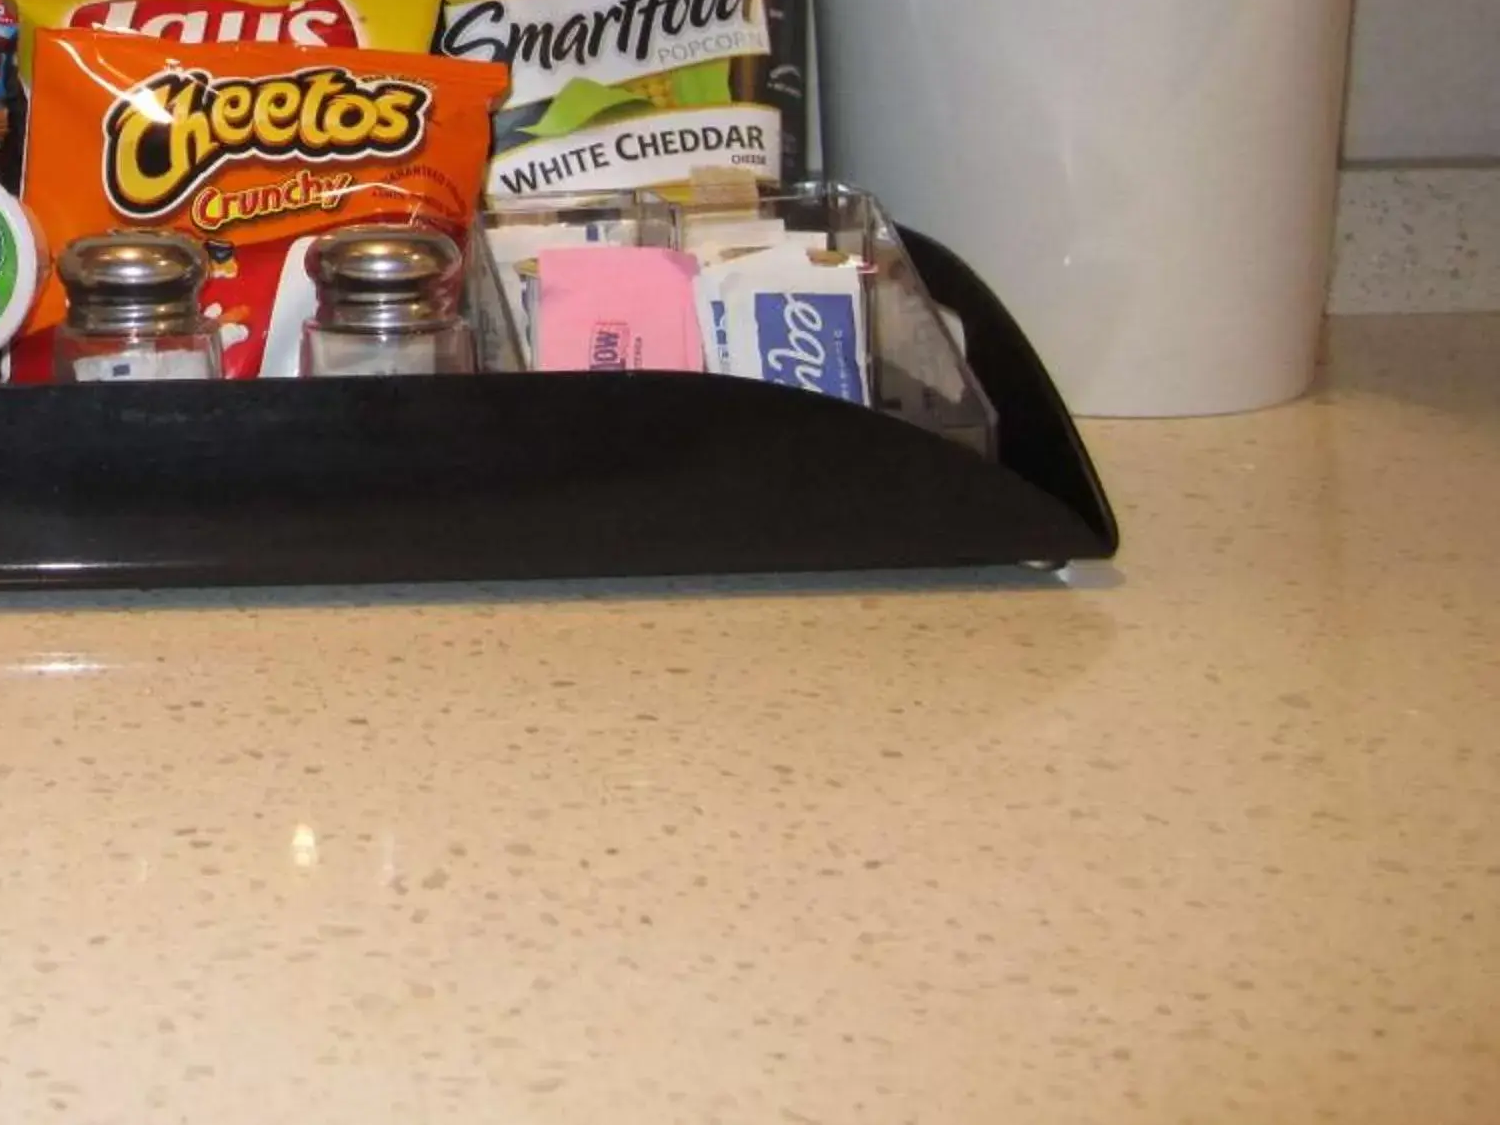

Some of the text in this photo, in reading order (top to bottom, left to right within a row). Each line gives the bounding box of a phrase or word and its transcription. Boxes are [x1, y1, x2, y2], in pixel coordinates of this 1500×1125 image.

[657, 31, 764, 64] POPCORN
[110, 69, 422, 210] Cheetos
[502, 124, 766, 195] WHITE CHEDDAR
[194, 171, 352, 228] Crunchy
